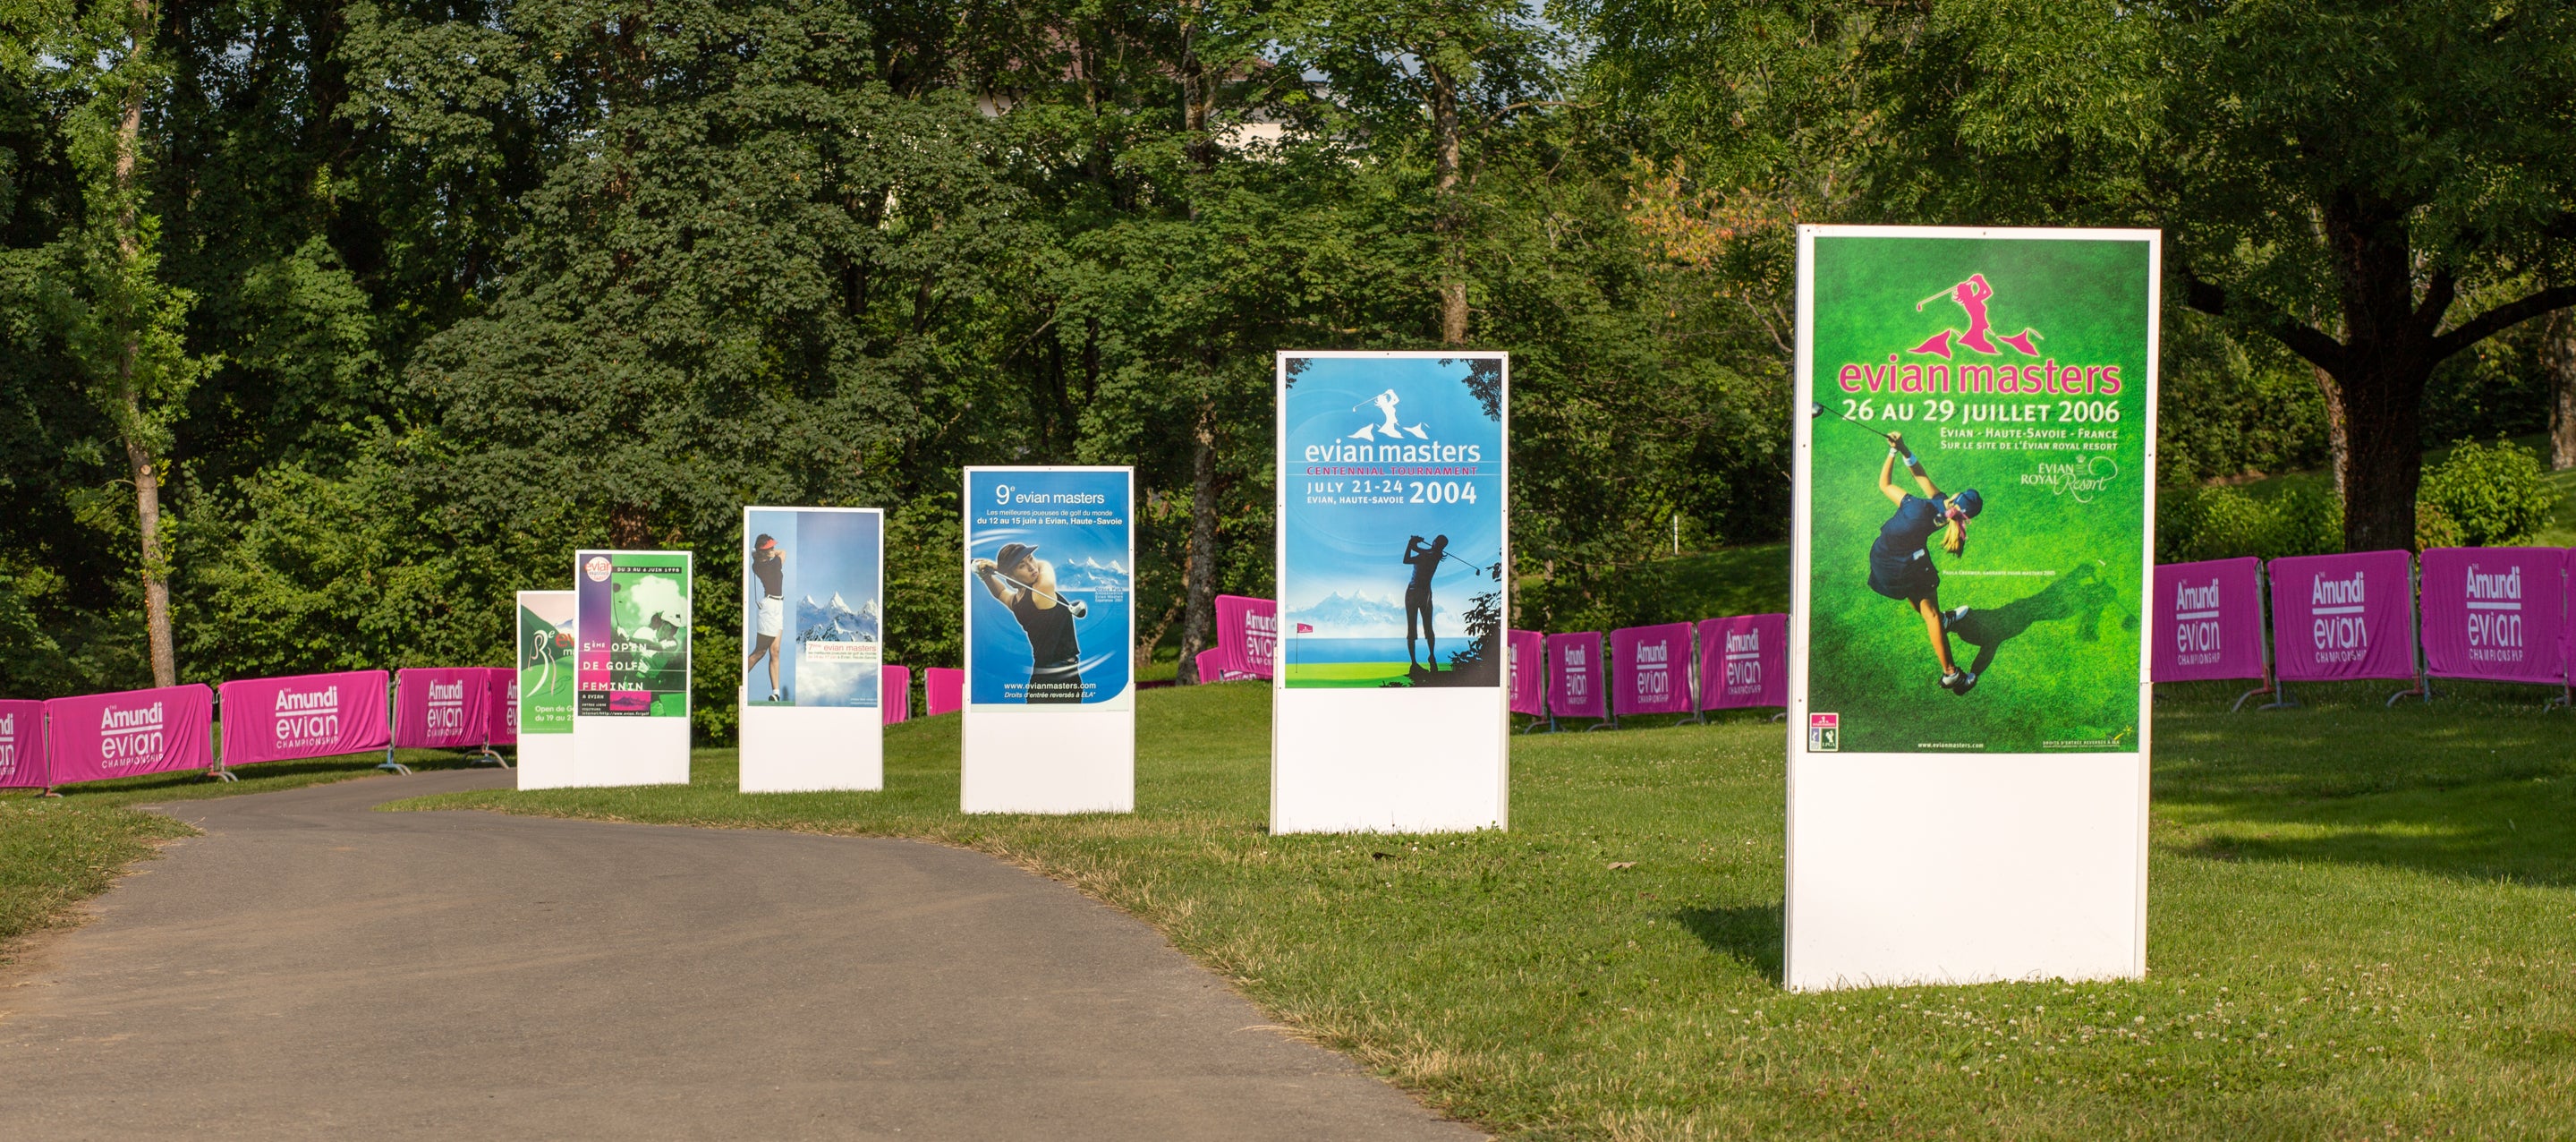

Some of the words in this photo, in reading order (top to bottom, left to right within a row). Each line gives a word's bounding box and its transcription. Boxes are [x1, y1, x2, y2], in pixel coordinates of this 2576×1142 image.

[1839, 354, 1949, 393] evian
[1959, 359, 2122, 395] masters
[1841, 398, 1874, 422] 26
[1881, 404, 1914, 421] AU
[1923, 399, 1955, 422] 29
[1962, 403, 2050, 424] JUILLET
[2058, 400, 2121, 422] 2006
[1305, 439, 1373, 463] evian
[1379, 440, 1481, 463] masters
[1963, 441, 1973, 449] LE
[1976, 440, 1996, 449] SITE
[2000, 441, 2011, 449] DE
[2053, 442, 2080, 450] ROYAL
[2083, 442, 2118, 450] RESORT
[1306, 466, 1385, 475] CENTENNIAL
[1390, 466, 1477, 475] TOURNAMENT
[2038, 463, 2074, 473] ÉVIAN
[1307, 482, 1344, 494] JULY
[1352, 480, 1403, 493] 21-24
[2021, 474, 2060, 485] ROYAL
[2053, 456, 2118, 503] Resort
[1016, 491, 1050, 504] evian
[1053, 492, 1105, 504] masters
[1307, 497, 1337, 505] EVIAN,
[1339, 496, 1404, 504] HAUTE-SAVOIE
[1409, 482, 1477, 504] 2004
[1022, 517, 1036, 525] juin
[1045, 517, 1068, 525] Evian,
[2176, 577, 2219, 610] Amundi
[2312, 571, 2365, 605] Amundi
[2466, 565, 2521, 600] Amundi
[1245, 609, 1277, 632] Amund
[2468, 611, 2522, 647] evian
[1725, 627, 1759, 652] Amundi
[2177, 620, 2221, 652] evian
[2313, 616, 2368, 650] evian
[611, 643, 647, 652] OPEN
[1246, 636, 1276, 658] evia
[1637, 639, 1667, 662] Amundi
[583, 661, 599, 670] DE
[606, 661, 638, 670] GOLF
[2177, 652, 2221, 666] CHAMPIONSHIP
[1637, 670, 1669, 694] evian
[1727, 660, 1761, 686] evian
[429, 679, 463, 700] Amundi
[582, 682, 643, 691] FEMININ
[276, 686, 338, 711] Amundi
[535, 705, 554, 714] Open
[101, 702, 163, 729] Amundi
[276, 714, 338, 739] evian
[427, 706, 463, 728] evian
[535, 714, 545, 722] du
[101, 731, 164, 759] evian
[276, 737, 338, 749] CHAMPIONSHIP
[101, 754, 164, 769] CHAMPIONSHIP
